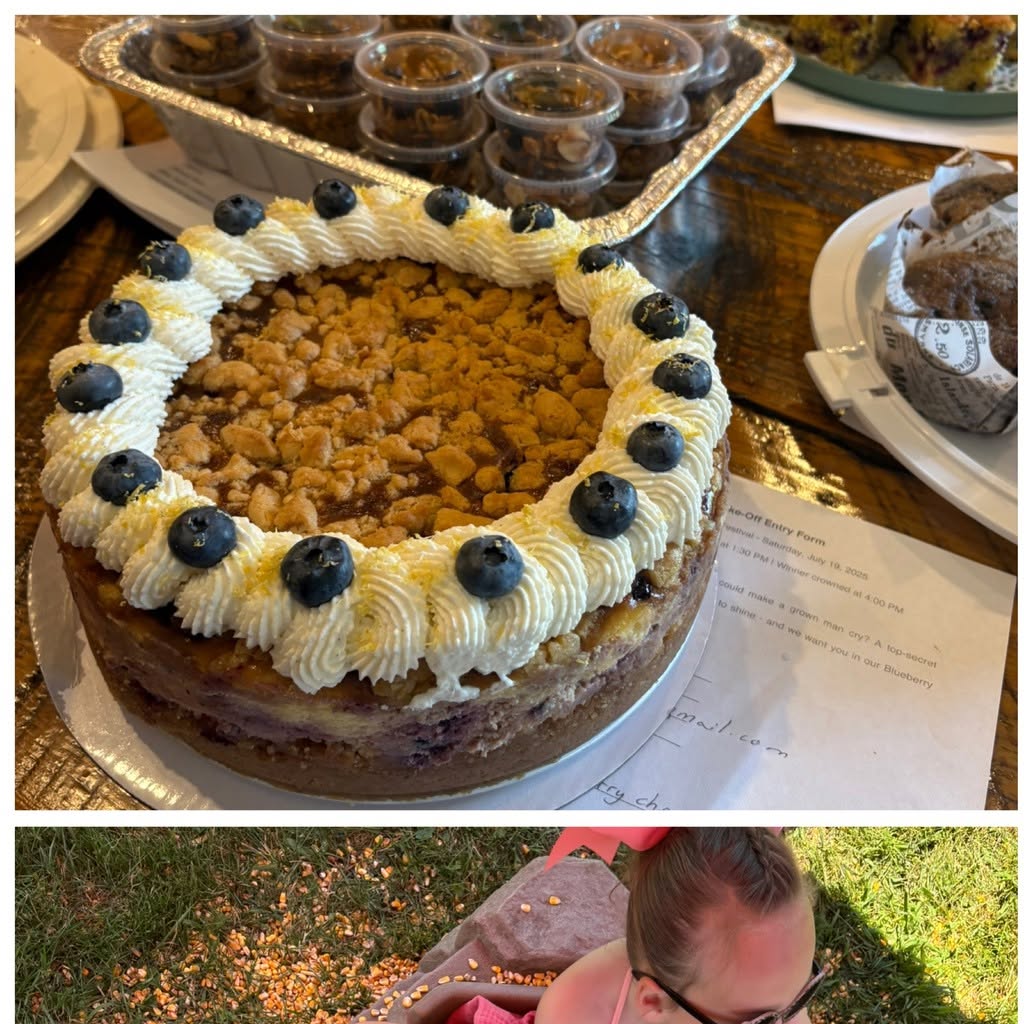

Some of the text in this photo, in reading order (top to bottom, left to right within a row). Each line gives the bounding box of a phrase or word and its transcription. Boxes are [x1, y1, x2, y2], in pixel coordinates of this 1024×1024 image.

[764, 518, 794, 536] Entry
[796, 530, 826, 547] Form
[753, 551, 769, 564] PM
[776, 560, 810, 577] Winner
[811, 573, 851, 593] crowned
[853, 588, 862, 599] at
[888, 602, 905, 615] PM
[807, 553, 827, 567] July
[845, 567, 869, 581] 2025
[718, 578, 745, 595] could
[747, 591, 775, 606] make
[789, 605, 819, 622] grown
[823, 618, 845, 633] man
[848, 630, 870, 643] cry?
[874, 639, 882, 649] A
[887, 643, 937, 669] top-secret
[718, 599, 728, 609] to
[730, 604, 757, 620] shine
[766, 616, 785, 630] and
[788, 625, 802, 637] we
[804, 632, 828, 649] want
[830, 643, 849, 658] you
[851, 651, 861, 662] in
[863, 656, 881, 669] our
[883, 663, 934, 689] Blueberry
